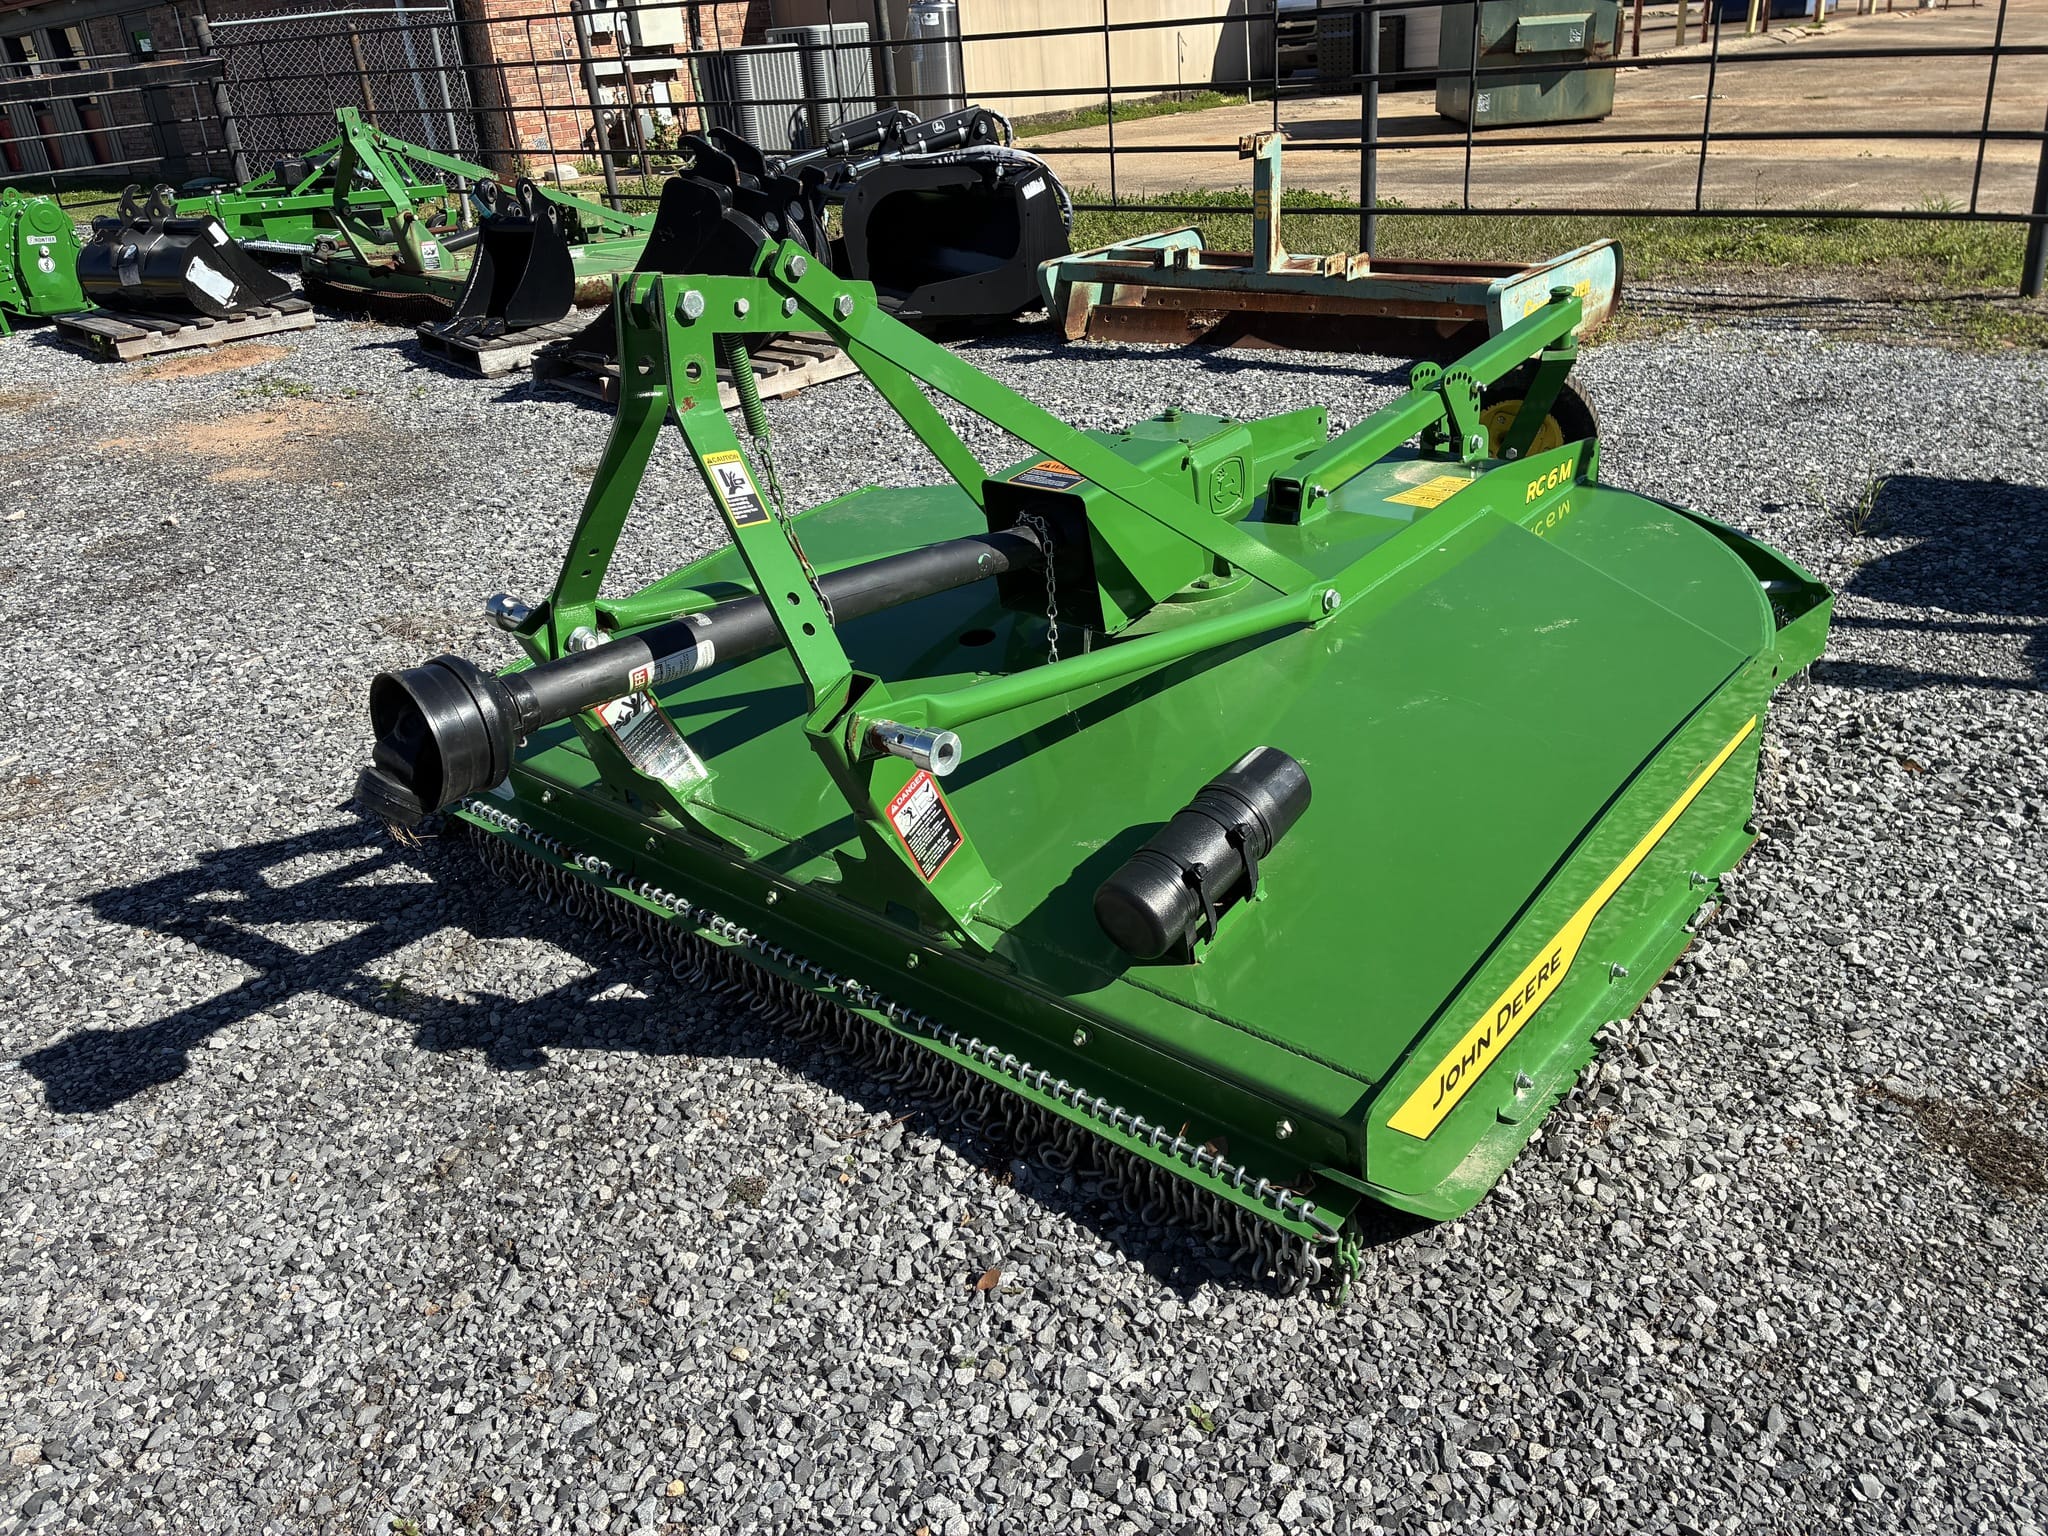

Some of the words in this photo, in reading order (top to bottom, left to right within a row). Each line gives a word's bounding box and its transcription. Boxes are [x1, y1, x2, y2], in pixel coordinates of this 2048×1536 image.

[711, 453, 739, 463] CAUTION
[896, 771, 926, 806] DANGER
[1432, 1027, 1491, 1111] JOHN
[1496, 947, 1562, 1037] DEERE
